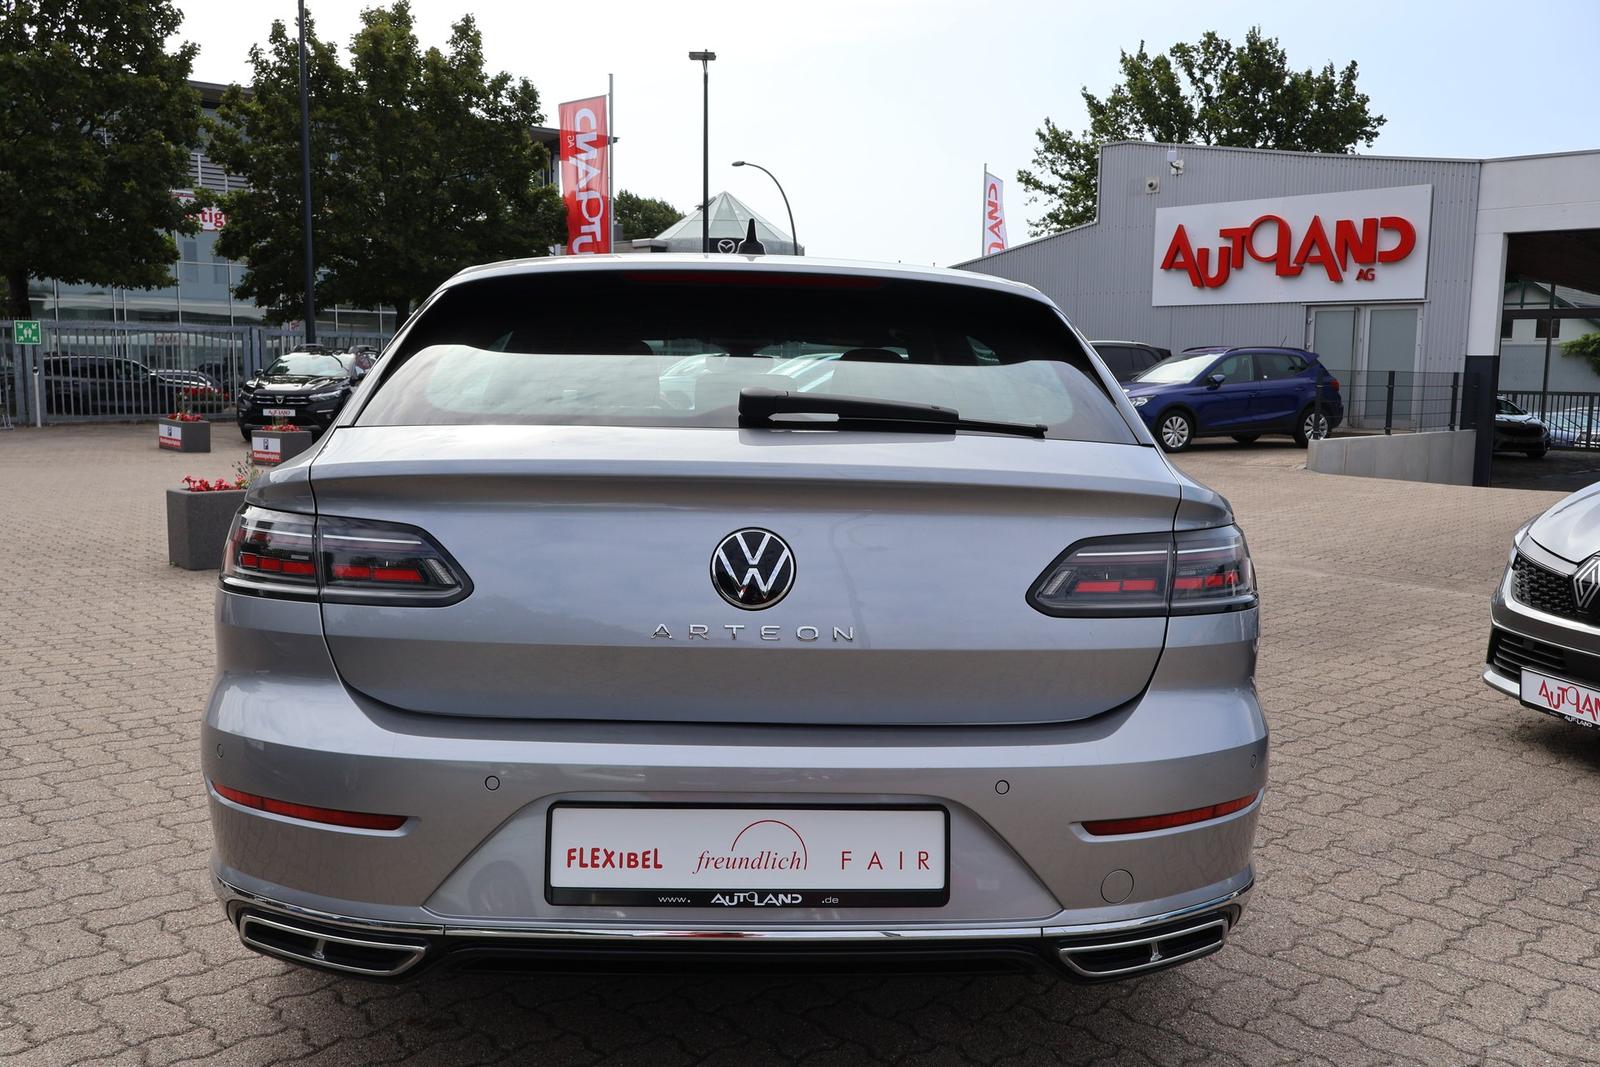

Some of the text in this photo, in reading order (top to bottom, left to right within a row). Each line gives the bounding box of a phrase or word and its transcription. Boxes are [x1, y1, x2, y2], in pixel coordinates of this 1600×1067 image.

[1160, 214, 1417, 289] AUTOLAND
[1355, 268, 1376, 281] AG
[650, 623, 854, 641] ARTEON
[566, 847, 663, 869] FLEXIBEL
[692, 850, 801, 875] freundlich
[710, 891, 803, 906] AUTOLAND
[821, 896, 839, 904] .de
